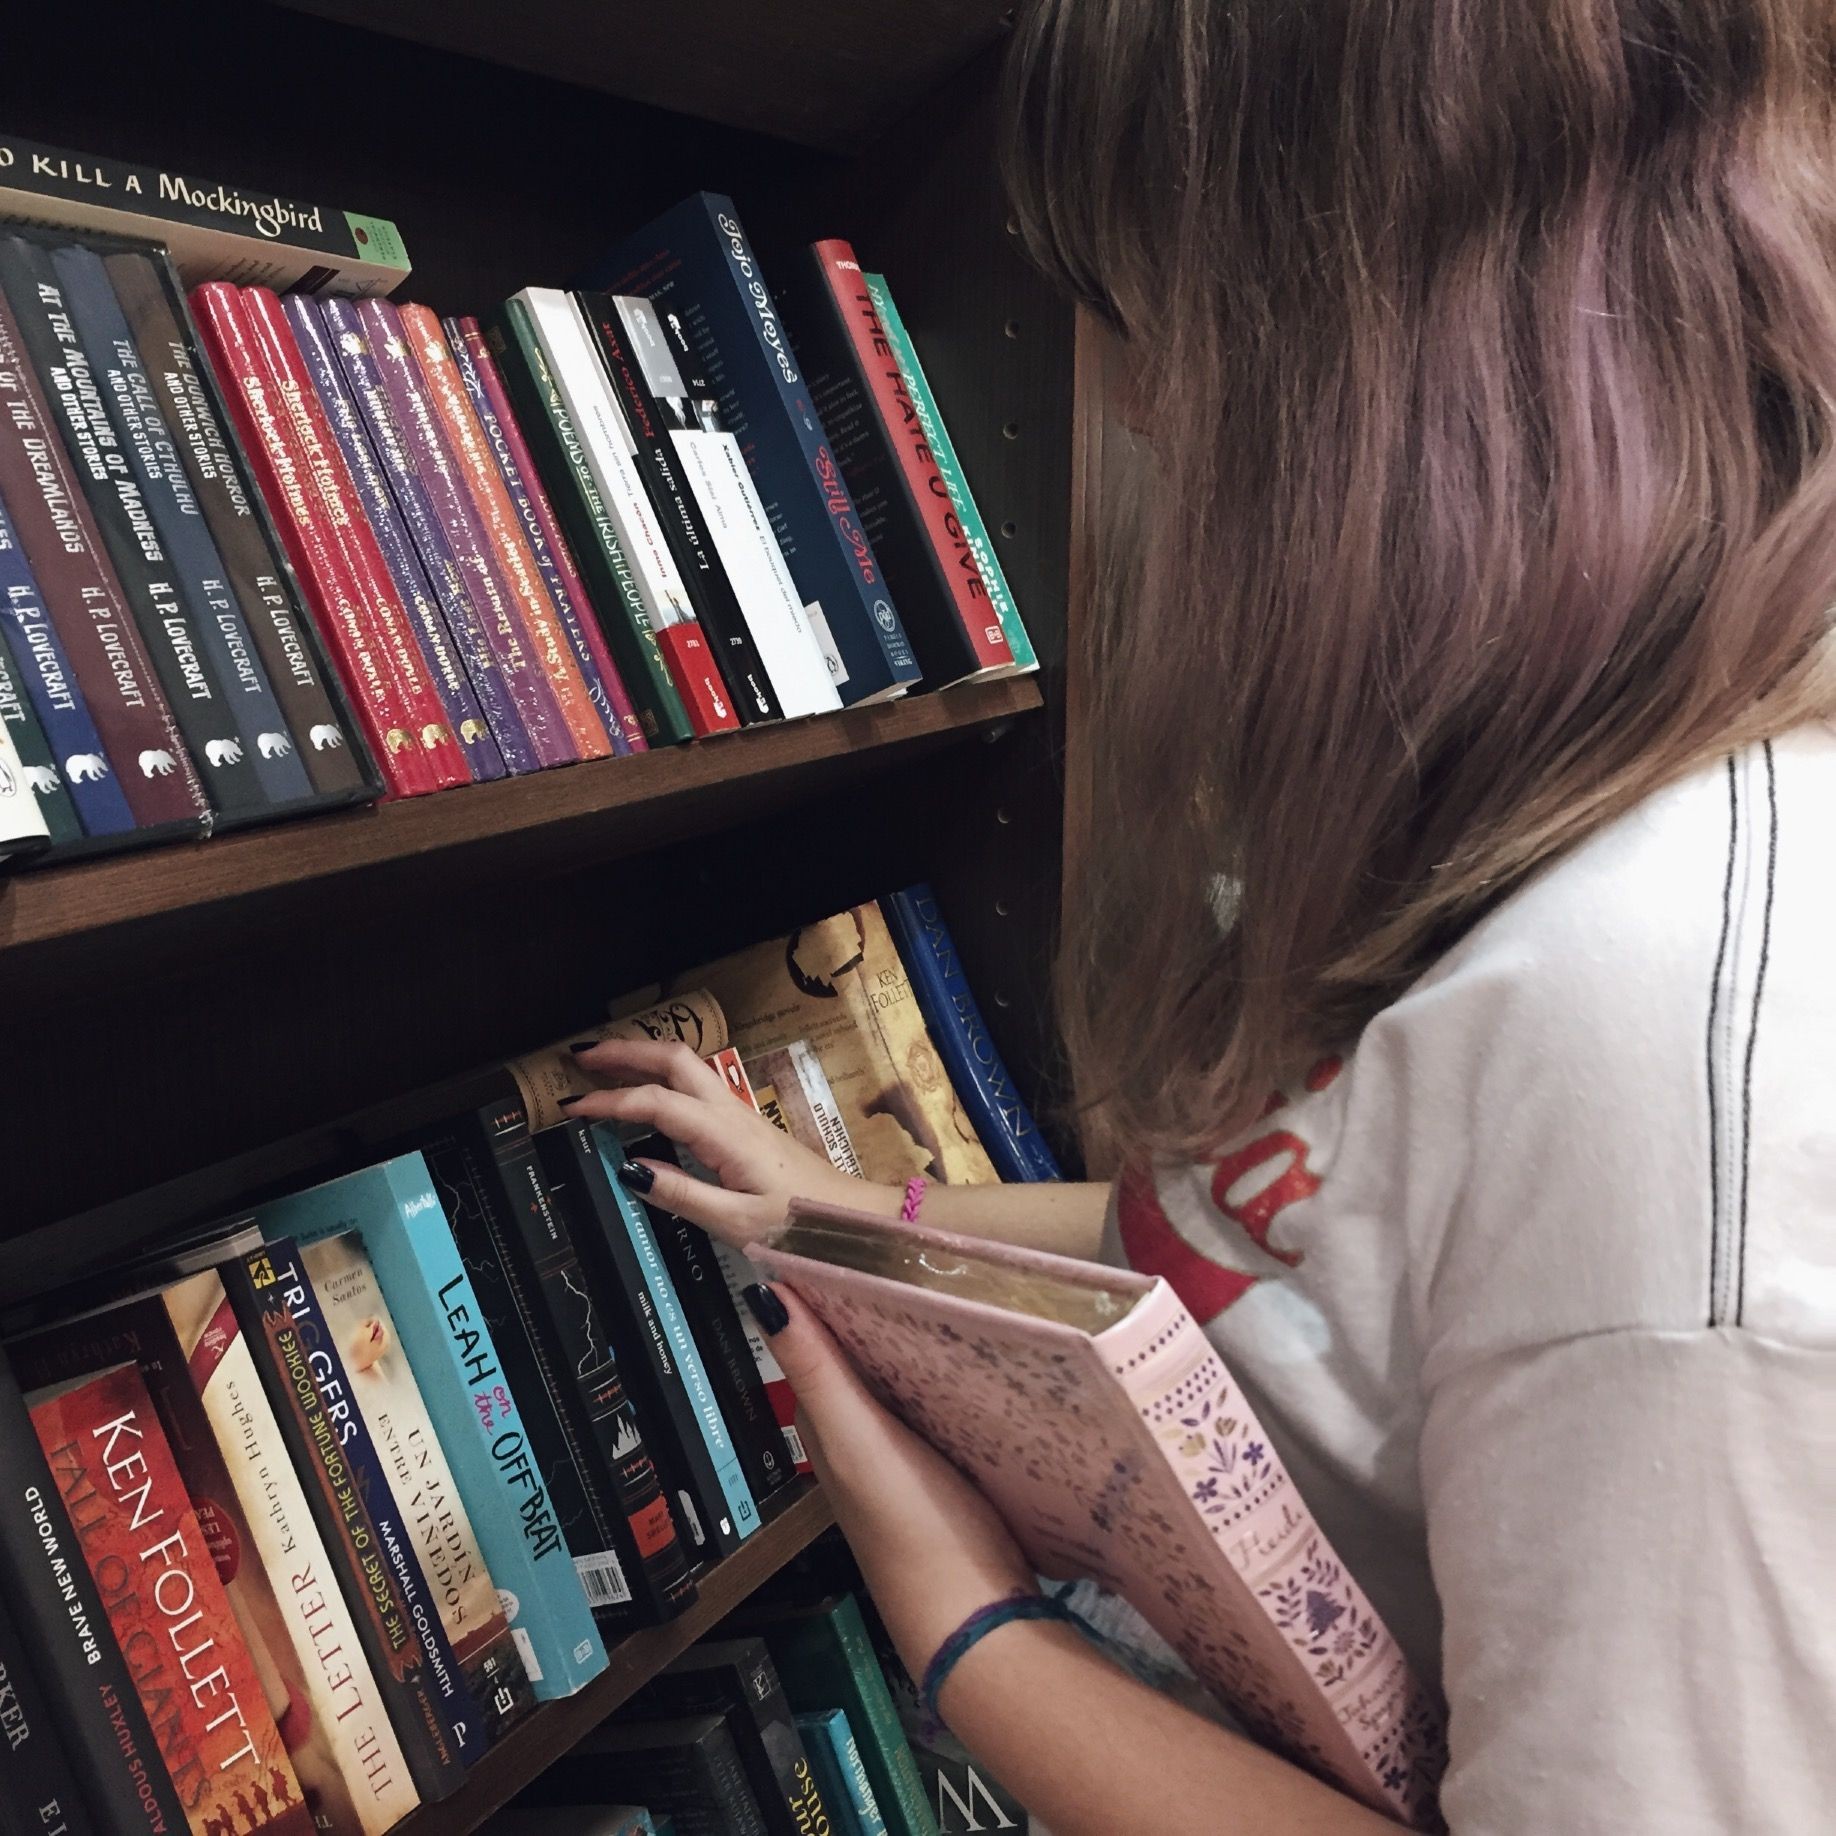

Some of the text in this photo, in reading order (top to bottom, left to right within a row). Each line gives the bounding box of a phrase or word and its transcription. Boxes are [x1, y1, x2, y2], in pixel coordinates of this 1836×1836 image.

[32, 154, 323, 238] KILL A Mockingbird
[717, 212, 753, 279] Jojo
[749, 281, 798, 385] Moyes
[37, 282, 164, 562] AT THE MOUNTAINS OF MADNESS
[50, 366, 109, 481] AND OTHER STORIES
[107, 369, 163, 480] AND OTHER STORIES
[113, 339, 200, 516] THE CALL OF CTHULHU
[163, 372, 218, 479] AND OTHER STORIES
[168, 341, 251, 517] THE DUNWICH HORROR
[244, 376, 310, 526] Sherlock Holmes
[281, 379, 349, 526] Sherlock Holmes
[619, 367, 655, 439] Federico
[856, 294, 986, 599] THE HATE U GIVE
[901, 372, 948, 464] PERFECT
[943, 469, 967, 513] LIFE
[6, 399, 37, 431] THE
[22, 438, 85, 554] DREAMLANDS
[554, 407, 653, 627] POEMS IRISH PEOPLE
[618, 467, 635, 497] Tierra
[655, 448, 678, 492] salida
[722, 443, 739, 480] Xabier
[815, 445, 851, 515] Still
[839, 515, 876, 585] Me
[483, 412, 592, 662] POCKET BOOK of PRAYERS
[633, 502, 654, 546] Chacón
[653, 549, 668, 579] Inma
[675, 496, 700, 547] última
[697, 550, 710, 571] La
[962, 525, 1004, 625] KINSELLA
[974, 537, 1009, 613] SOPHIE
[8, 584, 76, 711] H. P. LOVECRAFT
[81, 587, 145, 708] H. P. LOVECRAFT
[148, 582, 213, 701] H. P. LOVECRAFT
[202, 579, 262, 694] H. P. LOVECRAFT
[256, 576, 315, 687] H. P. LOVECRAFT
[376, 597, 402, 649] CONAN
[482, 577, 526, 674] The Return
[876, 968, 898, 988] KEN
[915, 898, 1032, 1138] DAN BROWN
[578, 1129, 592, 1154] kaur
[526, 1165, 558, 1241] FRANKENSTEIN
[323, 1268, 364, 1292] Carmen
[333, 1283, 367, 1306] Santos
[438, 1274, 498, 1386] LEAH
[627, 1200, 725, 1449] El amor no es un verso libre
[637, 1291, 673, 1376] milk and honey
[277, 1261, 358, 1447] TRIGGERS
[492, 1386, 512, 1419] on
[711, 1318, 756, 1422] DAN BROWN
[308, 1412, 345, 1487] FORTUNE
[474, 1394, 493, 1436] the
[50, 1439, 106, 1536] FALL
[96, 1555, 142, 1610] OF
[338, 1490, 358, 1522] THE
[351, 1524, 370, 1549] OF
[378, 1413, 468, 1625] ENTRE VIÑEDOS
[408, 1428, 476, 1585] UN JARDÍN
[491, 1432, 563, 1562] OFFBEAT
[25, 1486, 101, 1665] BRAVE NEW WORLD
[92, 1410, 261, 1771] KEN FOLLETT
[226, 1381, 394, 1801] THE LETTER Kathryn Hughes
[362, 1552, 396, 1613] SECRET
[379, 1520, 454, 1698] MARSHALL GOLDSMITH
[387, 1615, 407, 1649] THE
[99, 1684, 167, 1834] ALDOUS HUXLEY
